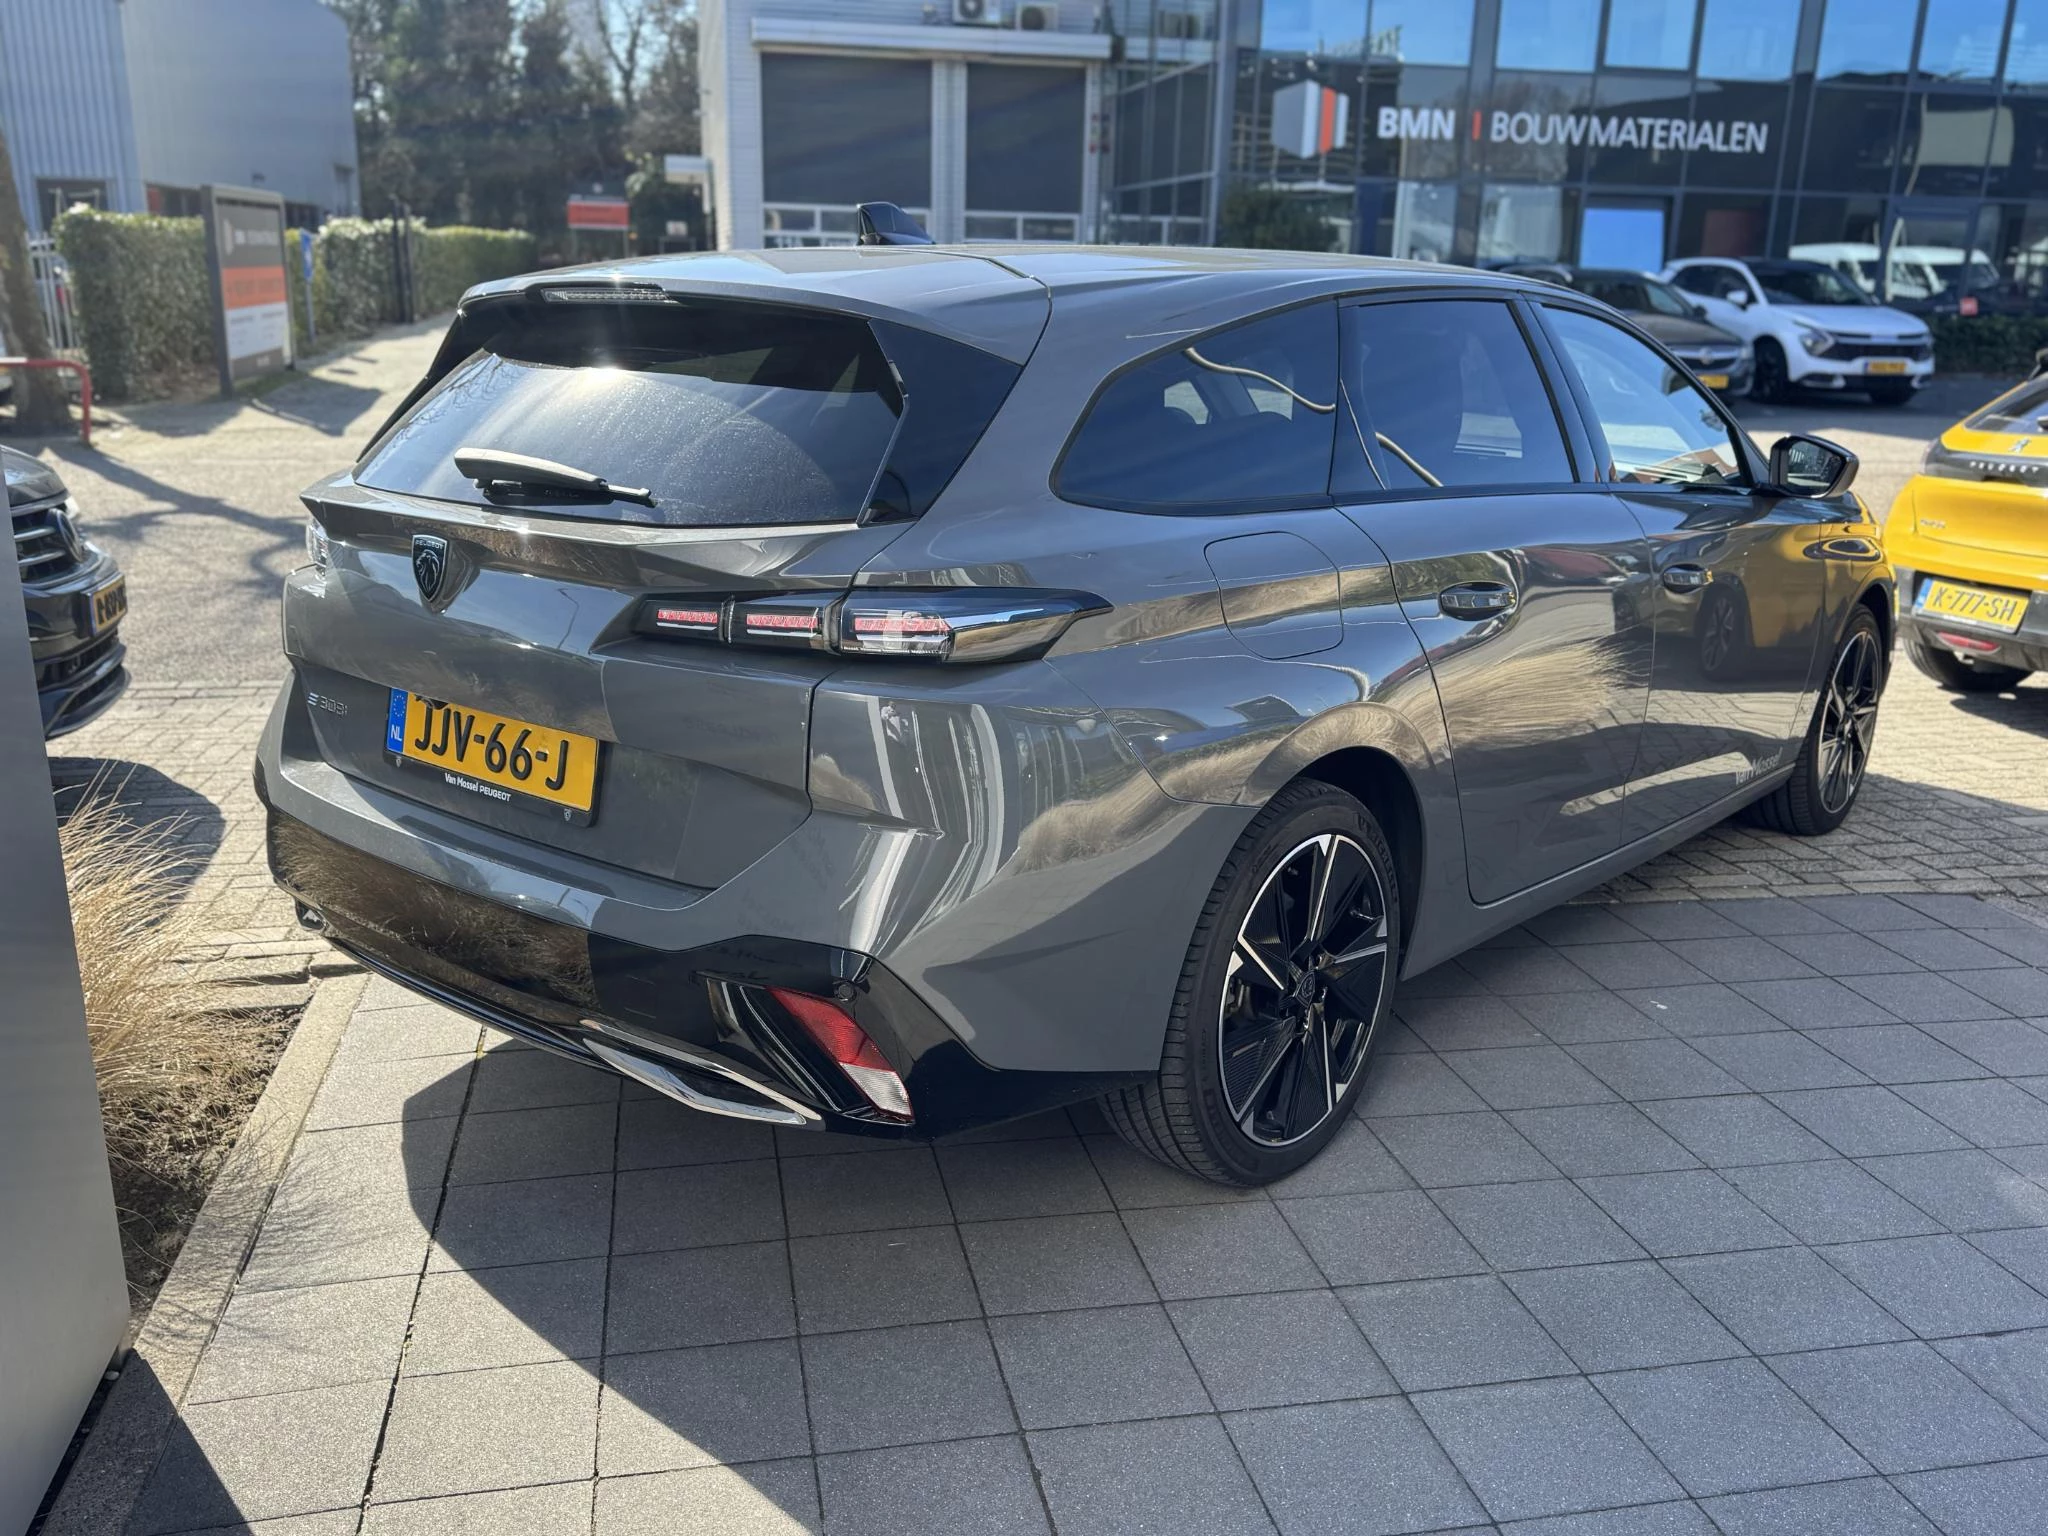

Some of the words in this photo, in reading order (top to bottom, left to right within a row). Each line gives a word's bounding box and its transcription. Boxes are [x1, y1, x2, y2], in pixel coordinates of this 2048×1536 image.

[1377, 106, 1456, 141] BMN
[1490, 110, 1768, 154] BOUWMATERIALEN
[1932, 586, 2018, 621] K-777-SH
[391, 723, 402, 742] NL
[415, 701, 569, 791] JJV-66-J
[444, 772, 456, 785] Van
[456, 776, 479, 792] Mossel
[479, 785, 512, 802] PEUGEOT
